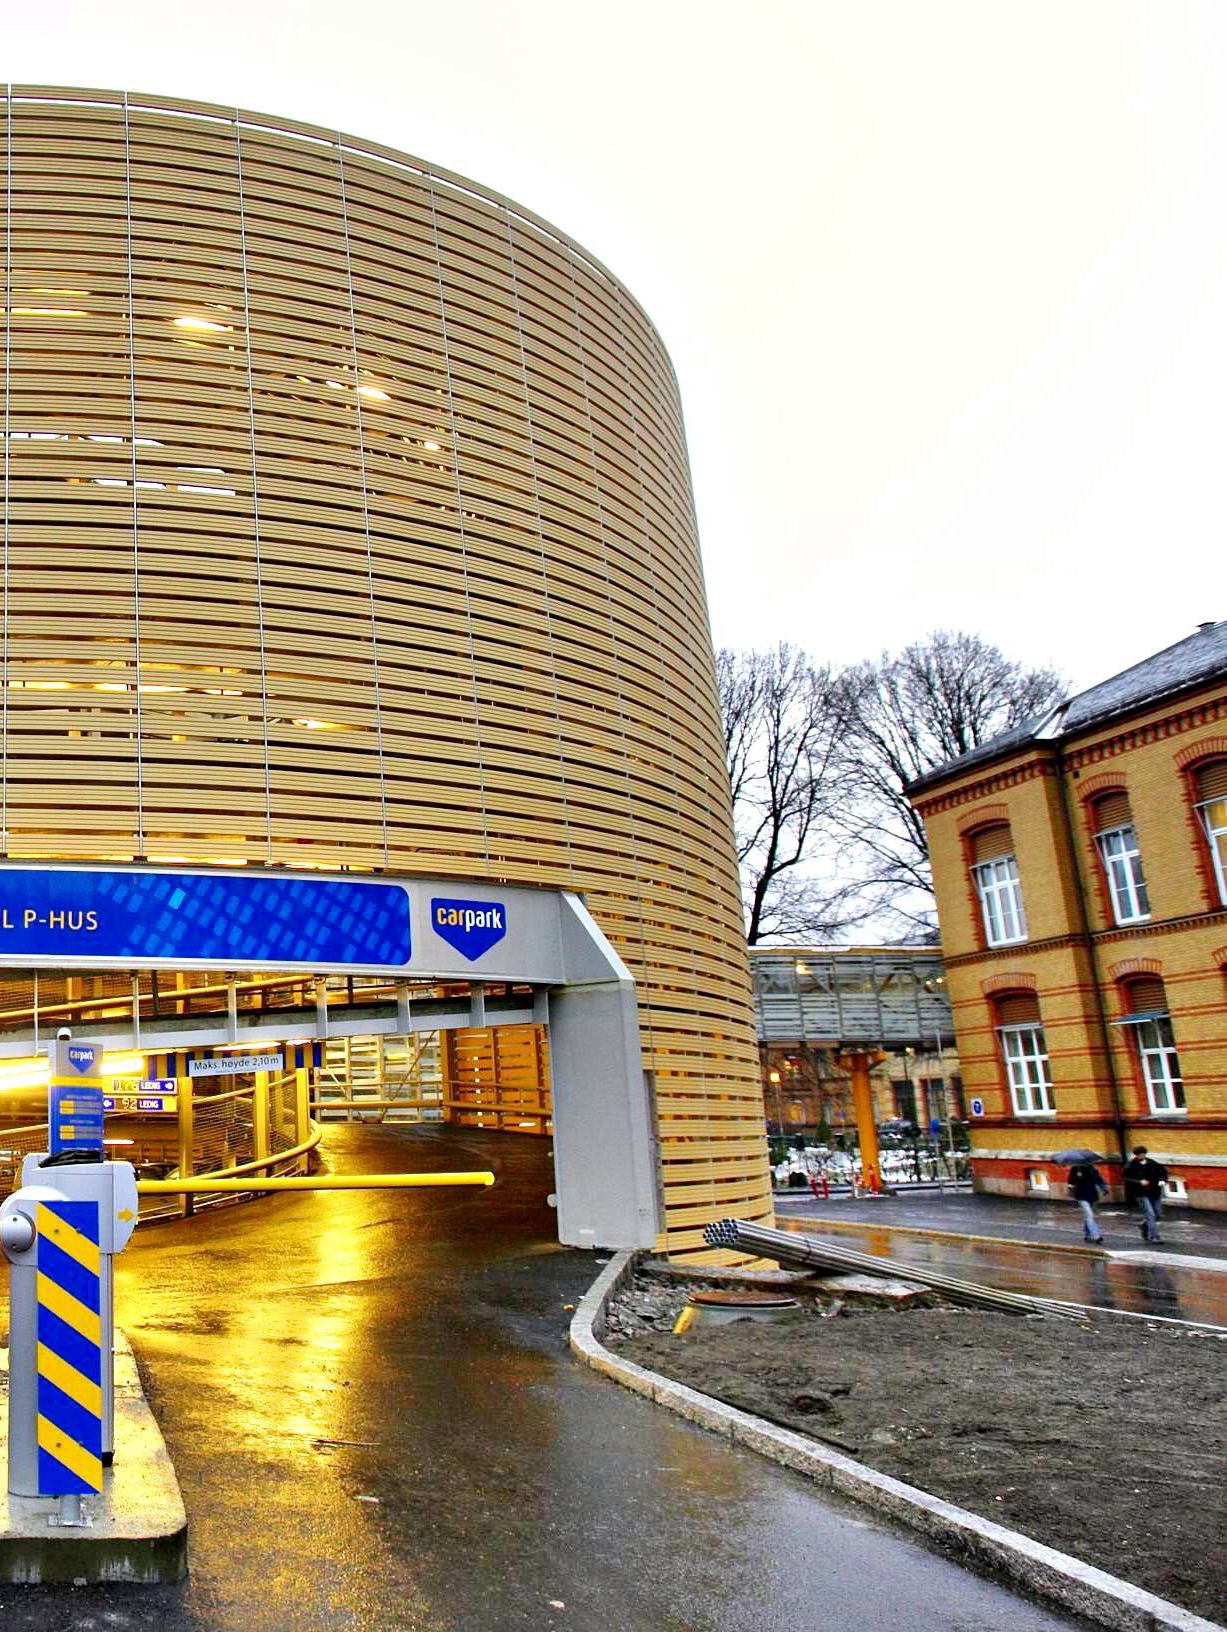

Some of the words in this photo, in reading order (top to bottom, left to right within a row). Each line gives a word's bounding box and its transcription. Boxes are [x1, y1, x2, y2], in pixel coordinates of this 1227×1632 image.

[24, 910, 99, 931] P-HUS
[437, 907, 503, 932] carpark
[70, 1050, 94, 1062] carpark
[194, 1060, 221, 1071] Maks.
[221, 1058, 250, 1069] høyde
[140, 1081, 161, 1090] LEDIG
[139, 1100, 159, 1109] LEDIG
